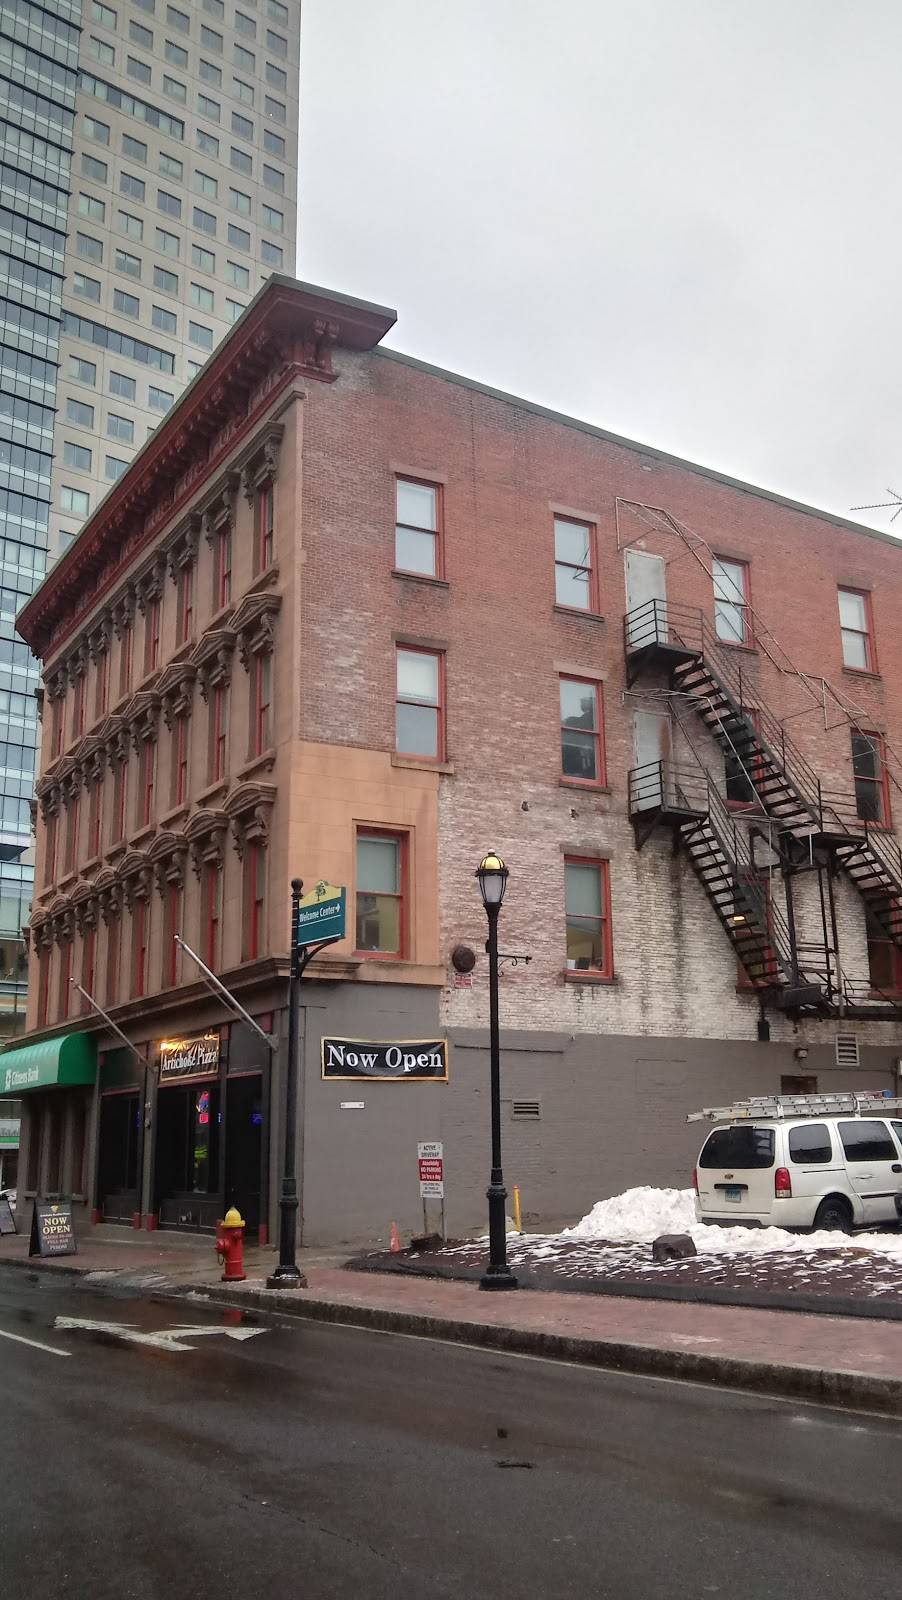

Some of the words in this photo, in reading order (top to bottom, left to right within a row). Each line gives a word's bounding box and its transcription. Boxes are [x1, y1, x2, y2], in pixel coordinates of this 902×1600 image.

[300, 911, 319, 922] Welcome
[320, 906, 335, 917] Center
[163, 1050, 195, 1070] Artichoke
[197, 1047, 217, 1065] Pizza
[327, 1045, 378, 1068] Now
[385, 1046, 443, 1072] Open
[28, 1065, 39, 1082] Bank
[44, 1217, 67, 1225] NOW
[43, 1225, 70, 1234] OPEN
